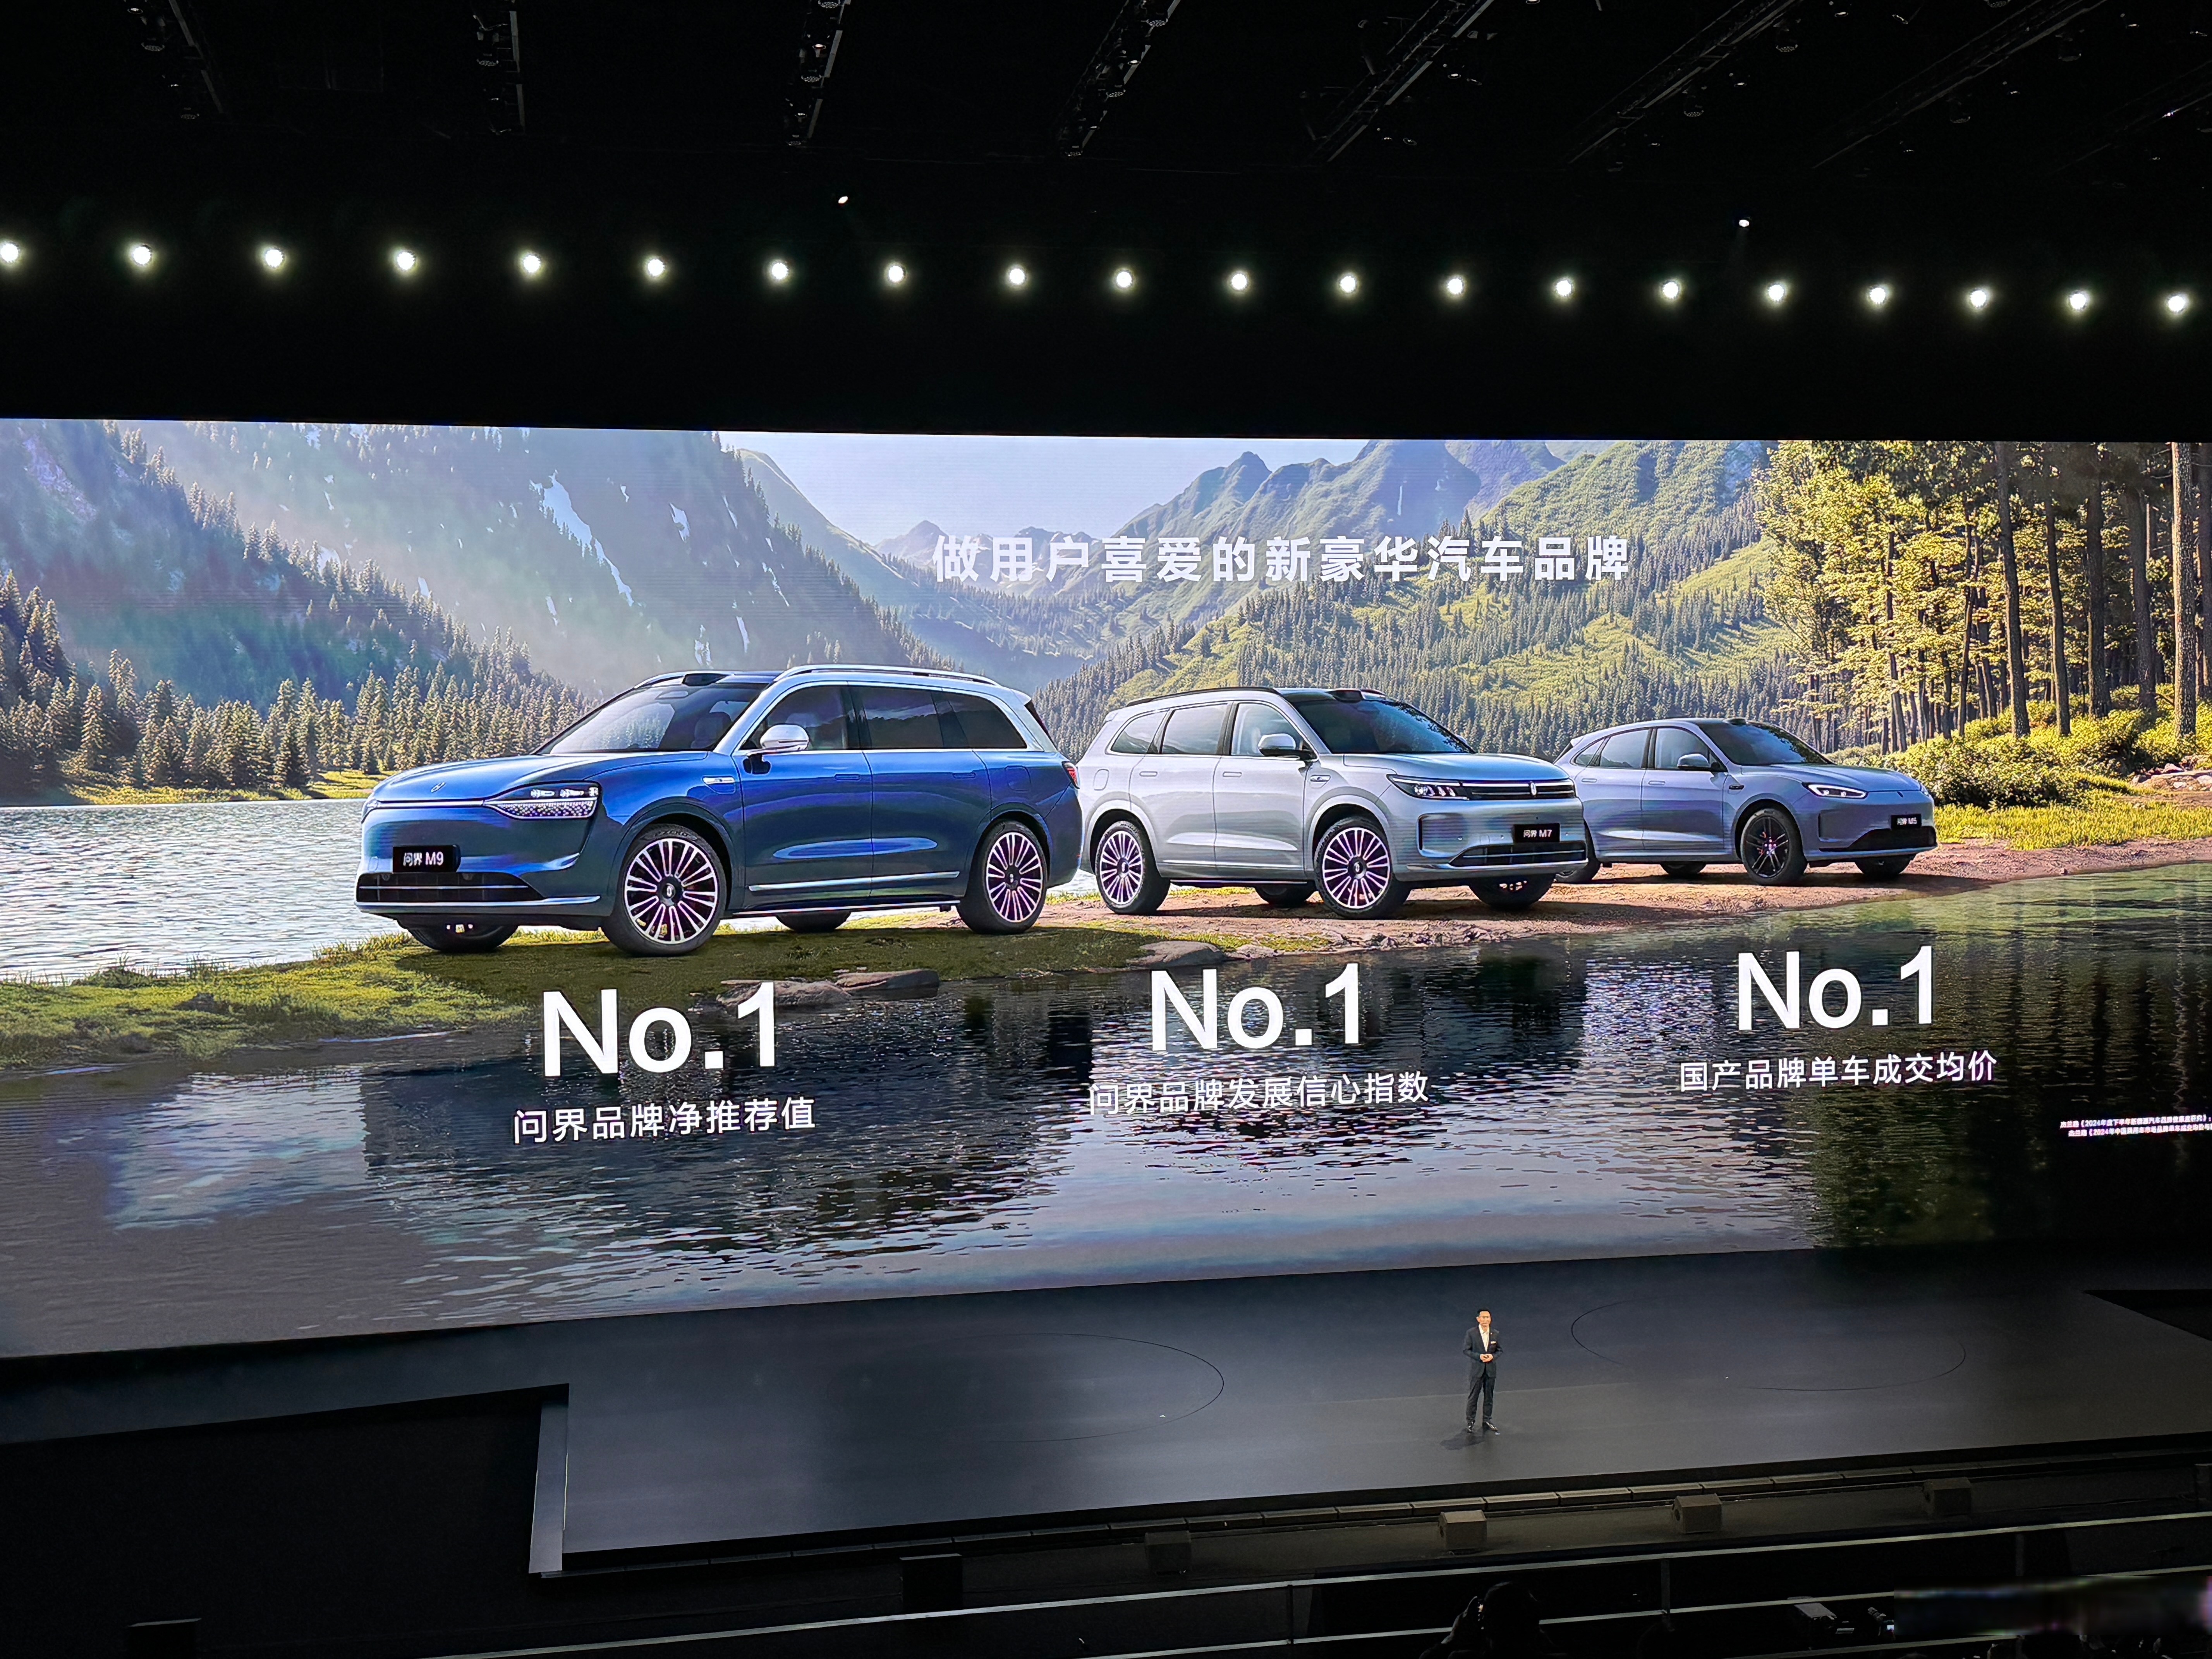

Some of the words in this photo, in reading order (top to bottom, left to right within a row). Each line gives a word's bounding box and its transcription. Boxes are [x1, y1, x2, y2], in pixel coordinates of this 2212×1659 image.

[933, 535, 1629, 582] 做用户喜爱的新豪华汽车品牌
[1539, 829, 1552, 838] M7
[425, 851, 444, 866] M9
[1151, 963, 1359, 1051] No.1
[1738, 946, 1933, 1030] No.1
[543, 982, 775, 1077] No.1
[1089, 1071, 1428, 1115] 问界品牌发展信心指数
[1680, 1050, 1997, 1092] 国产品牌单车成交均价
[514, 1096, 815, 1144] 问界品牌净推荐值
